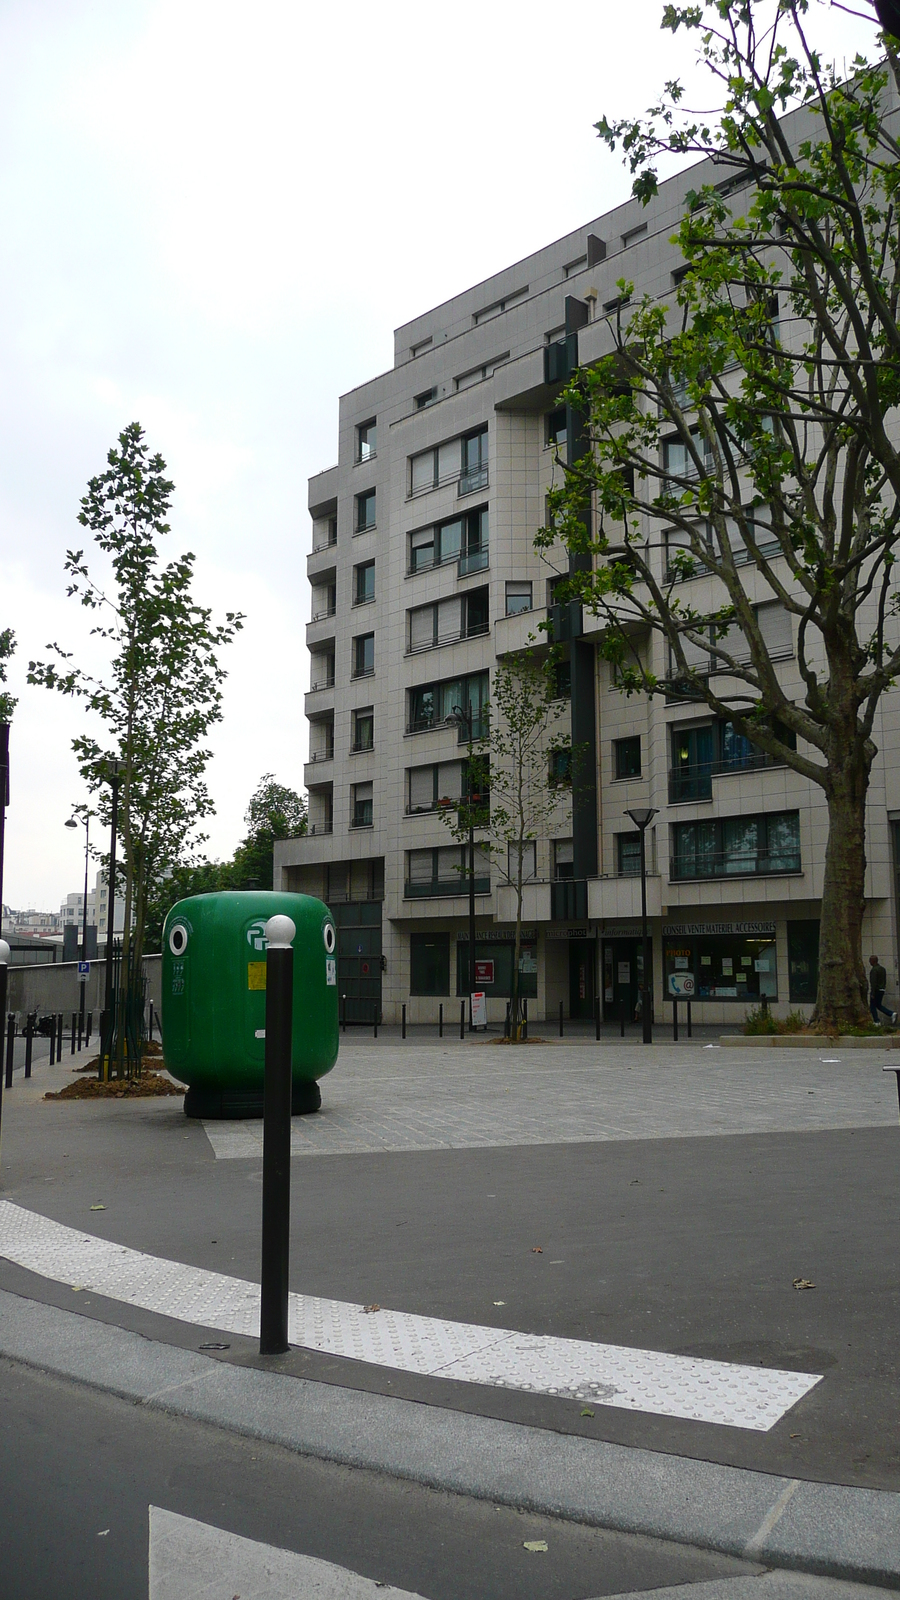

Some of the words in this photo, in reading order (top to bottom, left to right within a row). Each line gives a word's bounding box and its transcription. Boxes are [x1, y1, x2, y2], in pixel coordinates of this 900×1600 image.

[662, 925, 686, 935] CONSEIL
[687, 925, 705, 934] VENTE
[736, 922, 776, 932] ACCESSOIRES
[666, 949, 691, 957] PHOTO
[80, 963, 87, 972] P
